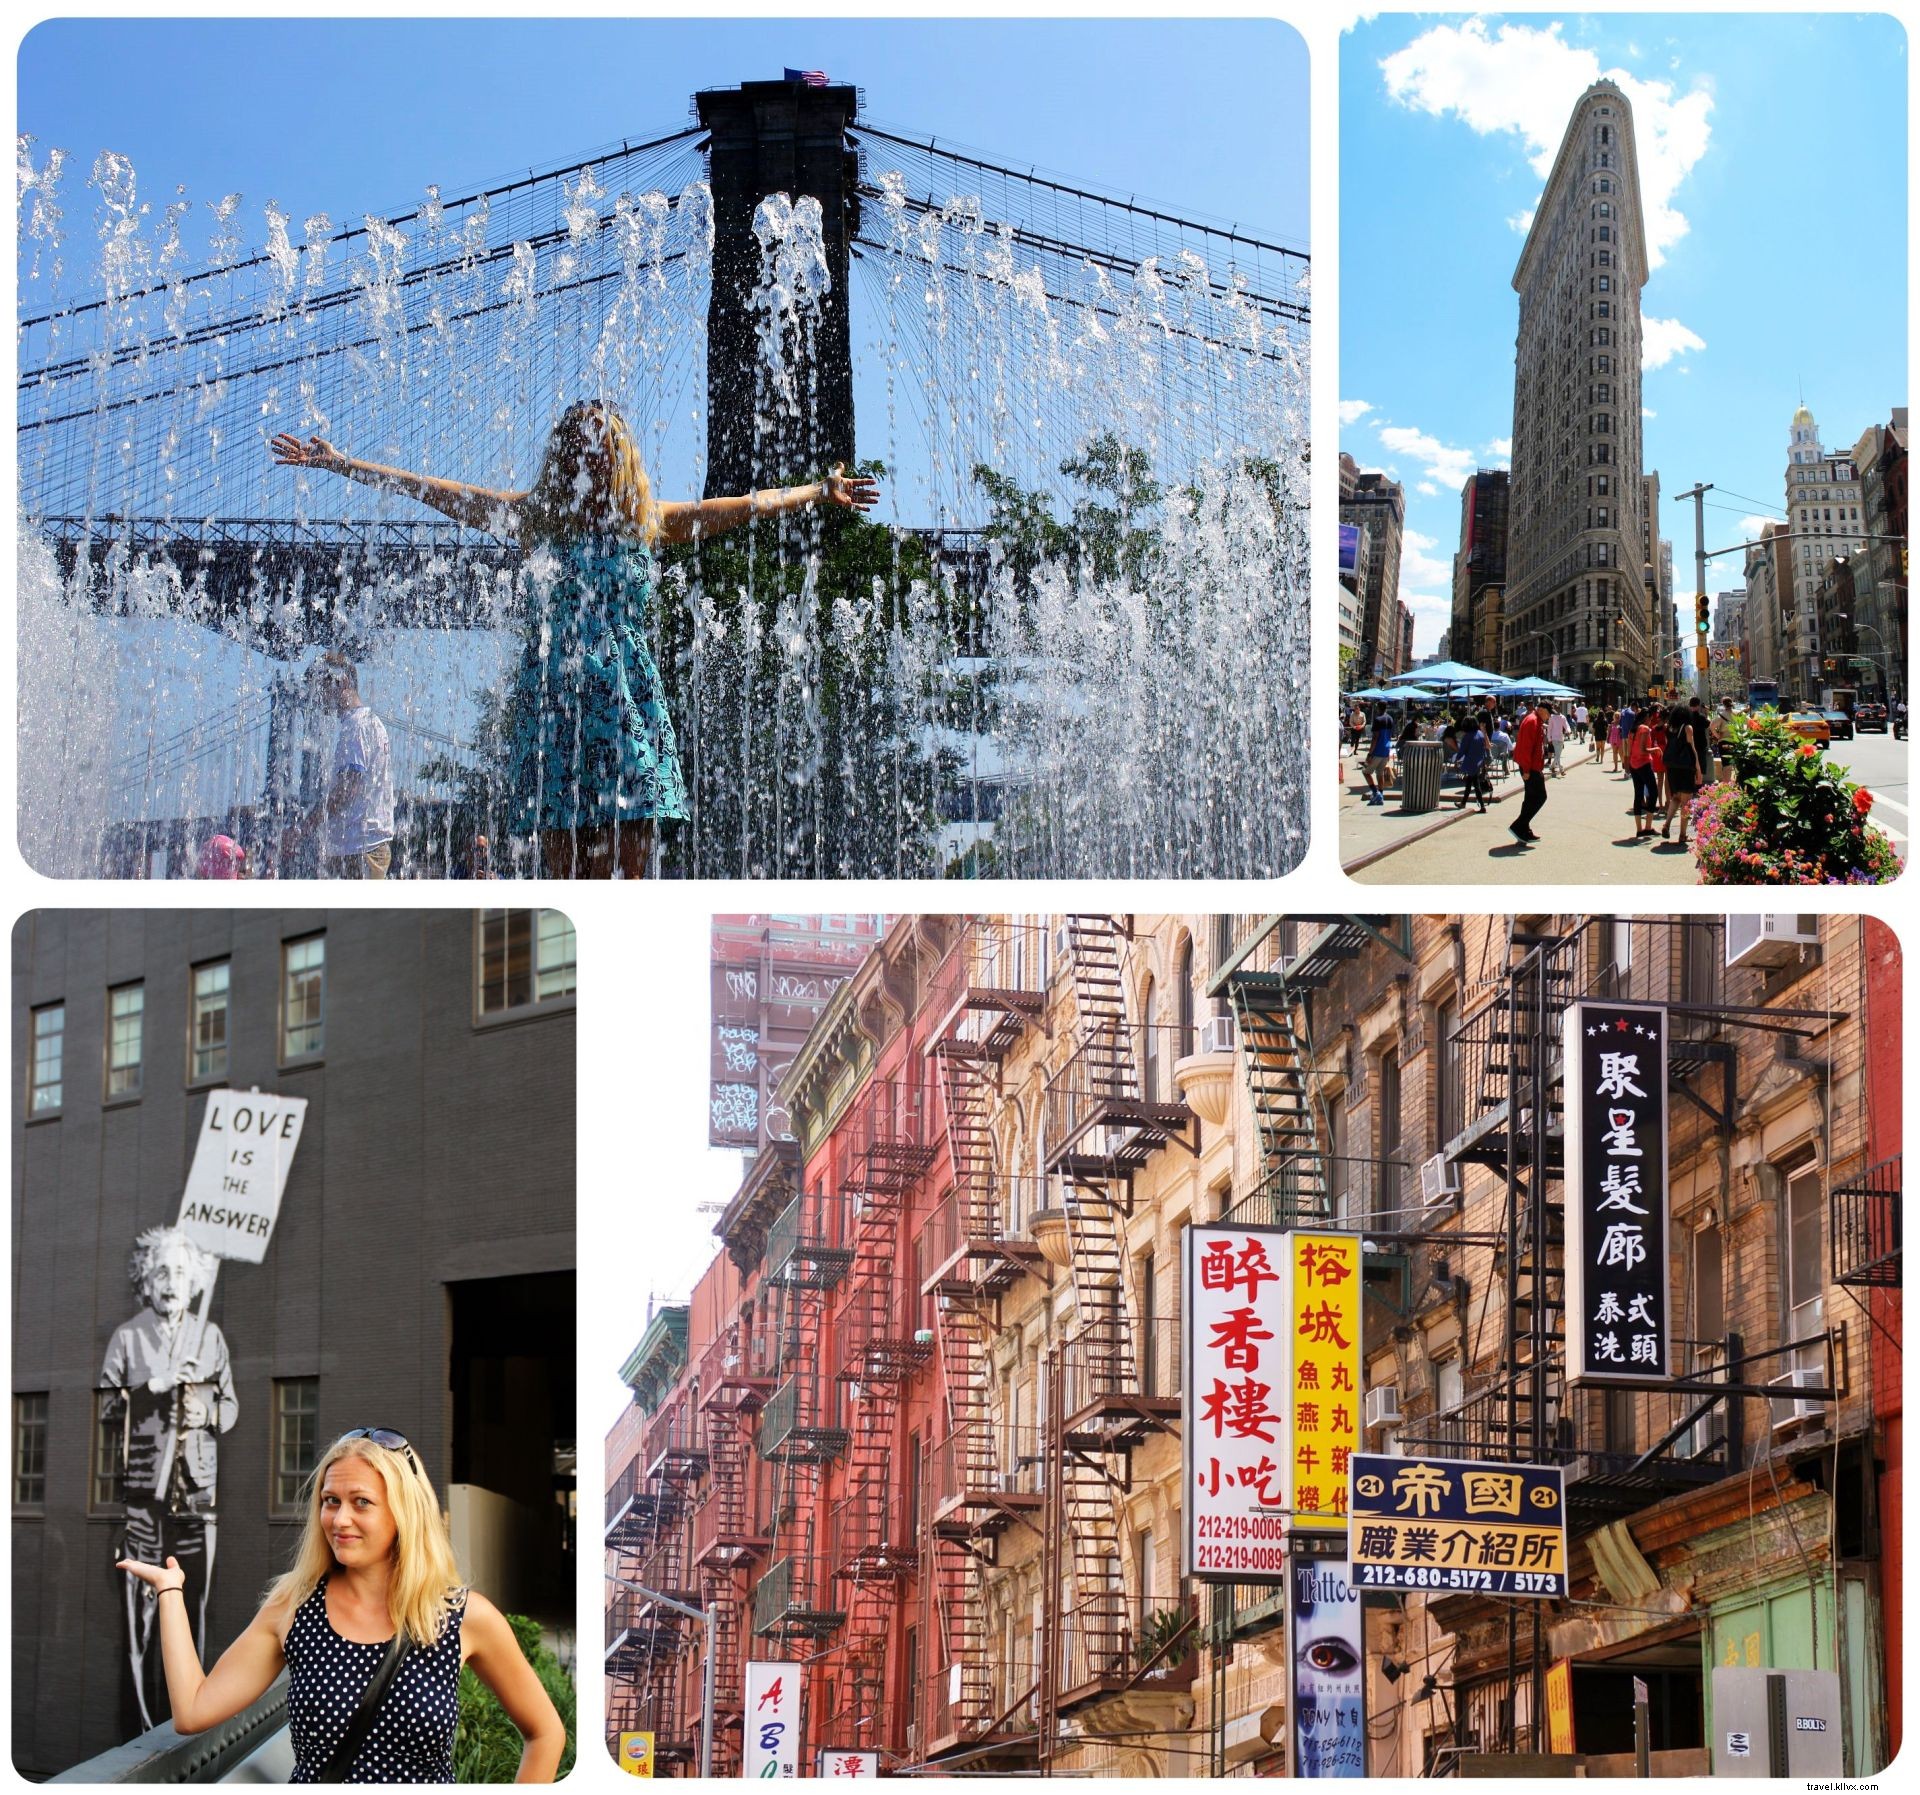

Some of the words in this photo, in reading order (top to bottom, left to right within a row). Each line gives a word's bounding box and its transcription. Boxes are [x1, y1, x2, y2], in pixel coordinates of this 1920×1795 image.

[210, 1107, 295, 1138] LOVE
[231, 1150, 253, 1165] IS
[1597, 1052, 1649, 1272] 聚星髮廊
[223, 1176, 248, 1194] THE
[184, 1202, 269, 1238] ANSWER
[1299, 1243, 1351, 1350] 榕城
[1594, 1292, 1656, 1328] 泰式
[1200, 1237, 1281, 1444] 醉香樓
[1594, 1332, 1658, 1366] 洗頭
[1297, 1360, 1353, 1392] 魚丸
[1297, 1402, 1353, 1434] 燕丸
[1198, 1455, 1282, 1506] 小吃
[1361, 1479, 1380, 1493] 21
[1392, 1462, 1524, 1517] 帝國
[1534, 1491, 1553, 1504] 21
[1198, 1515, 1282, 1540] 212-219-0006
[1198, 1545, 1282, 1570] 212-219-0089
[1357, 1526, 1558, 1568] 職業介紹所
[1363, 1565, 1492, 1589] 212-680-5172
[1498, 1571, 1507, 1591] /
[1514, 1574, 1557, 1592] 5173
